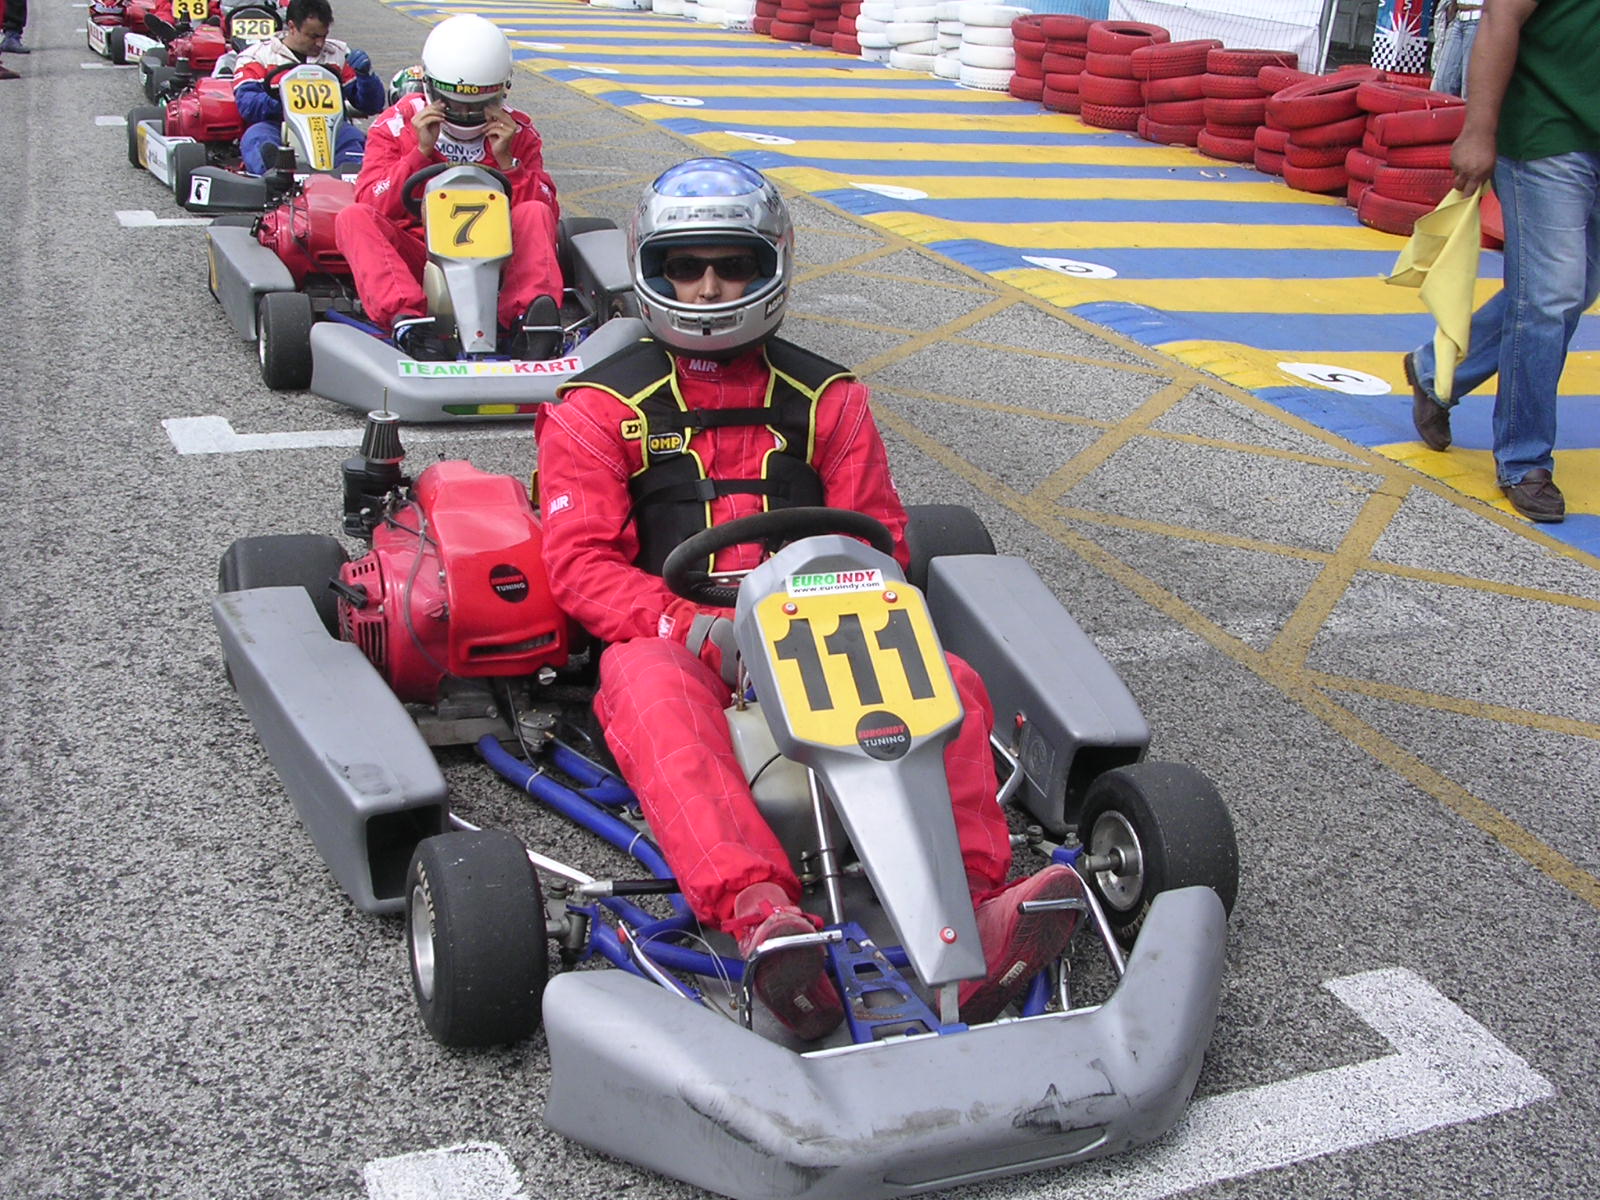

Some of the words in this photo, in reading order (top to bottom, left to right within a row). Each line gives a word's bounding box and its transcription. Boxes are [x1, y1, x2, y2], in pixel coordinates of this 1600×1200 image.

[235, 20, 271, 35] 326
[292, 84, 334, 110] 302
[450, 202, 489, 247] 7
[400, 362, 467, 375] TEAM
[689, 359, 718, 372] MIR
[651, 436, 680, 450] OMP
[792, 571, 875, 587] EUROINDY
[496, 582, 525, 592] TUNING
[793, 582, 880, 593] www.euroindy.com
[774, 608, 936, 712] 111
[864, 735, 905, 747] TUNING
